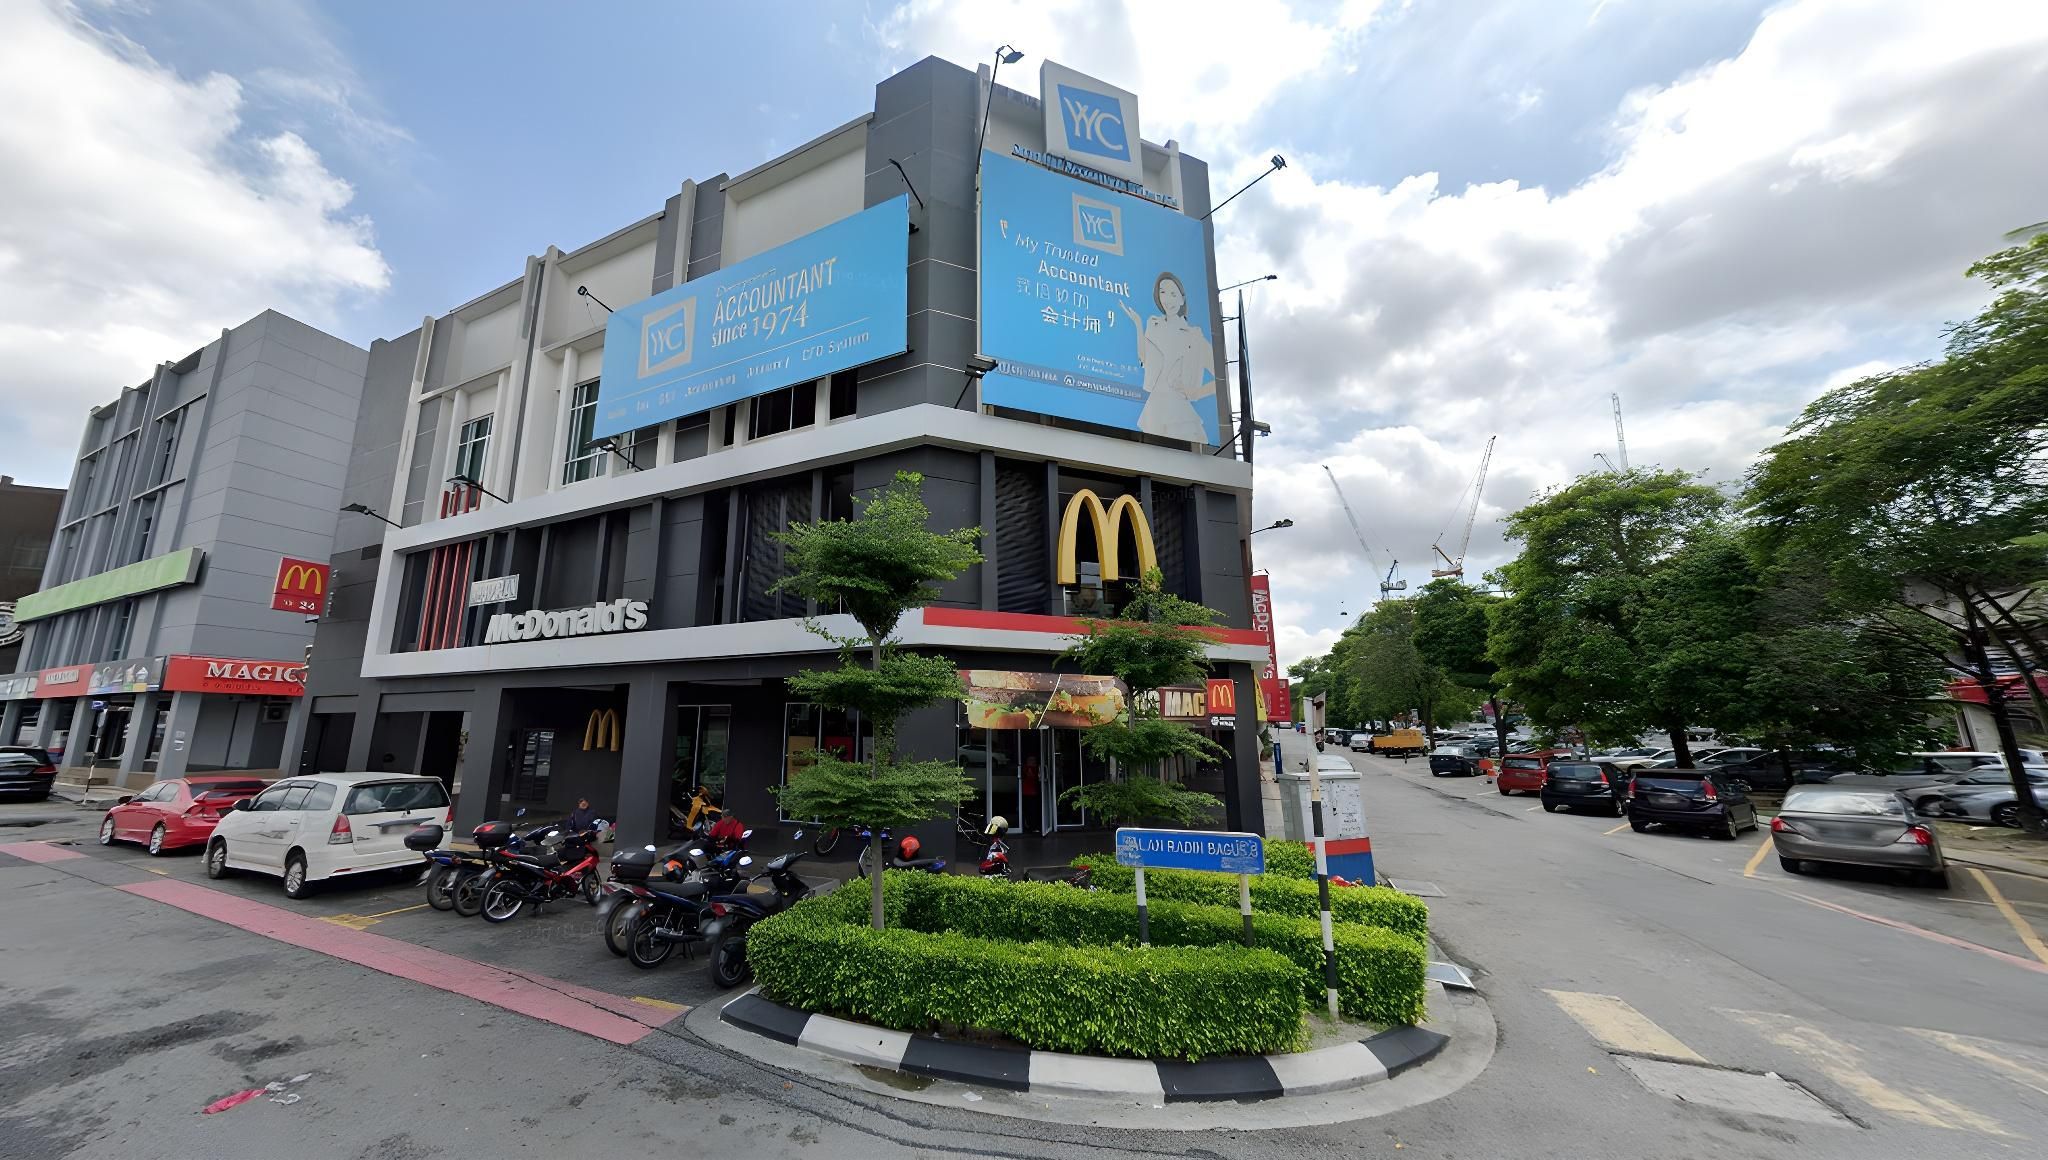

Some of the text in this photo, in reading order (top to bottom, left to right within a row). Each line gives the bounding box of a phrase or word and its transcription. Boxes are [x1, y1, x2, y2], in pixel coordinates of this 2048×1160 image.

[712, 256, 838, 328] ACCOUNTANT
[753, 299, 809, 341] 1974
[484, 599, 648, 644] McDonald's
[1164, 690, 1206, 717] MAC
[1123, 836, 1164, 852] ALAN
